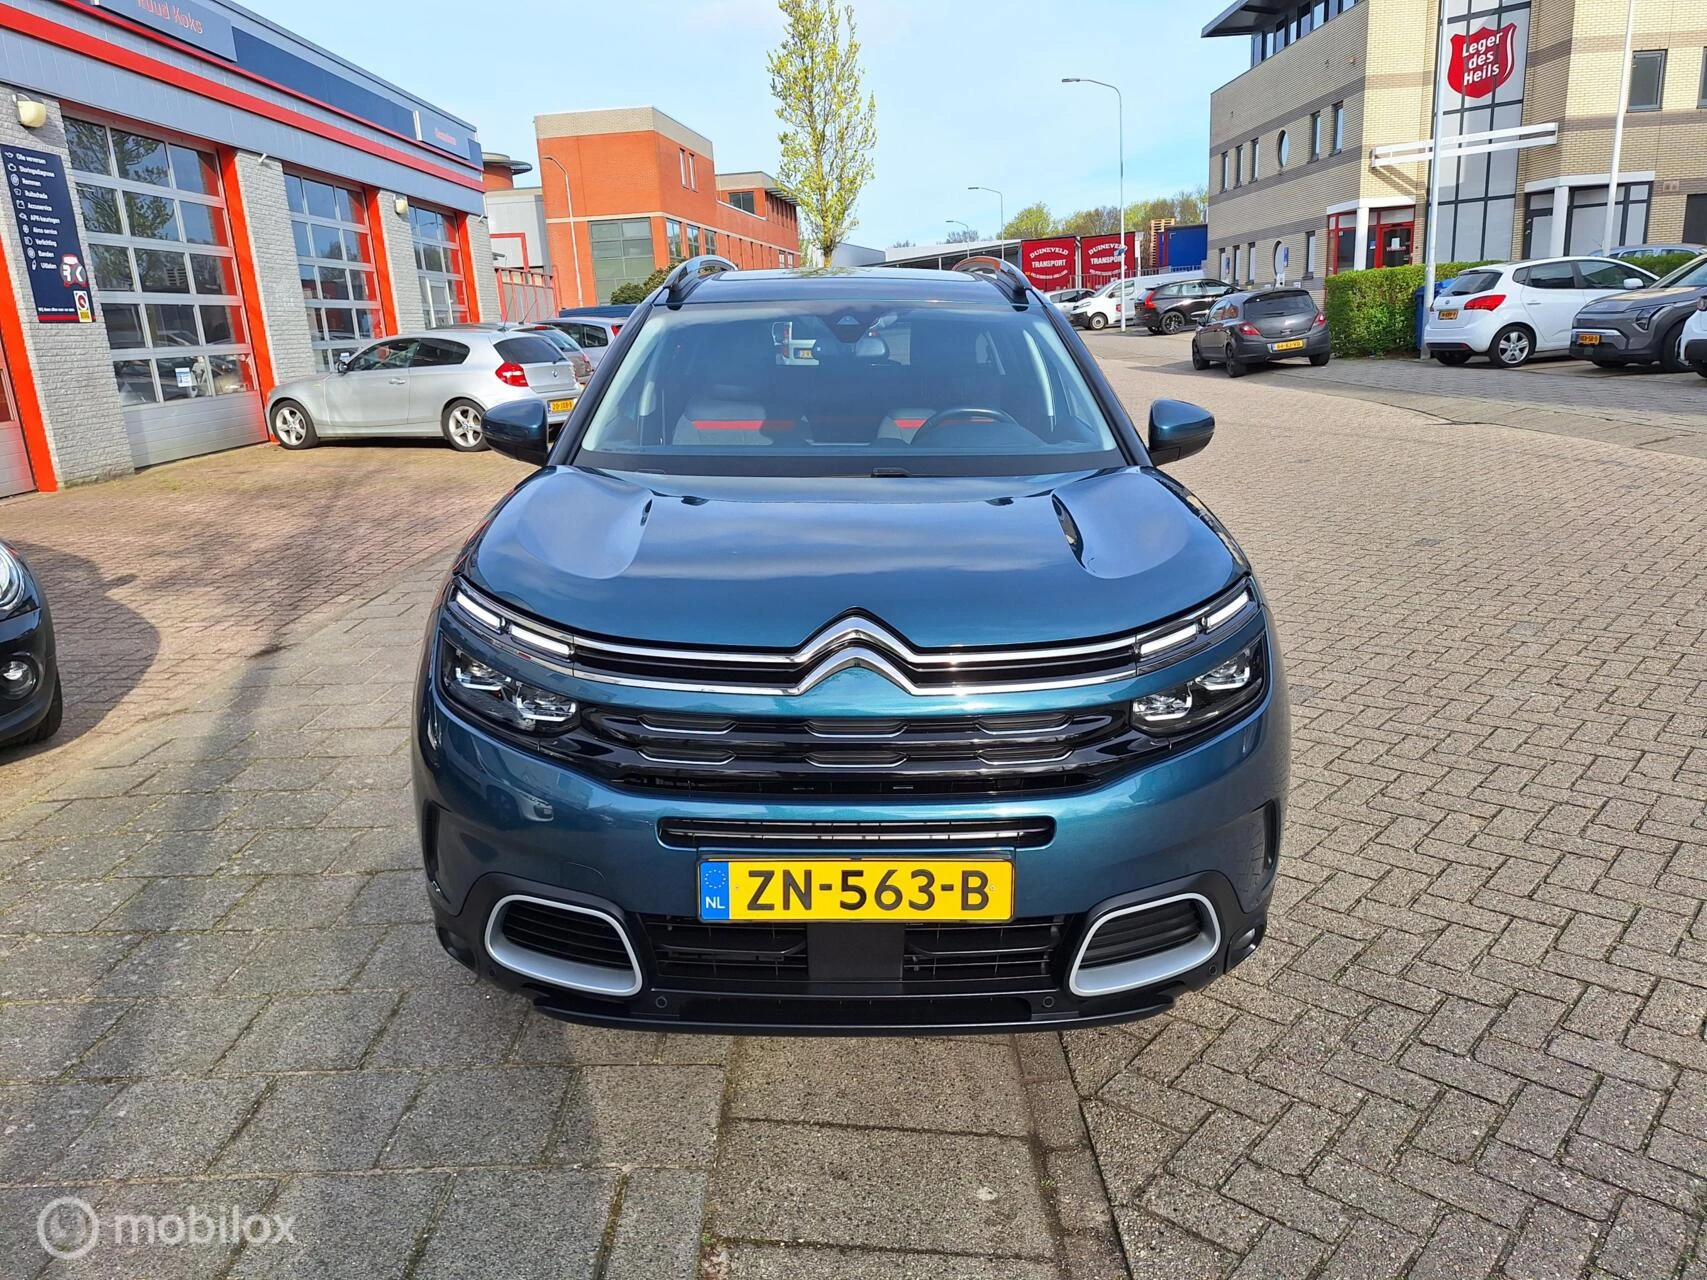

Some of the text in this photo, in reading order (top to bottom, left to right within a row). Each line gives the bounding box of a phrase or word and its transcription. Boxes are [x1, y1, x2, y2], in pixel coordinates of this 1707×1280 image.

[173, 6, 203, 34] Koks
[1462, 32, 1503, 57] Leger
[1468, 51, 1494, 69] des
[1463, 64, 1499, 86] Heils
[1029, 246, 1069, 258] DUINEVELD
[1032, 259, 1067, 268] TRANSPORT
[747, 869, 989, 911] ZN-563-B
[704, 896, 725, 909] NL
